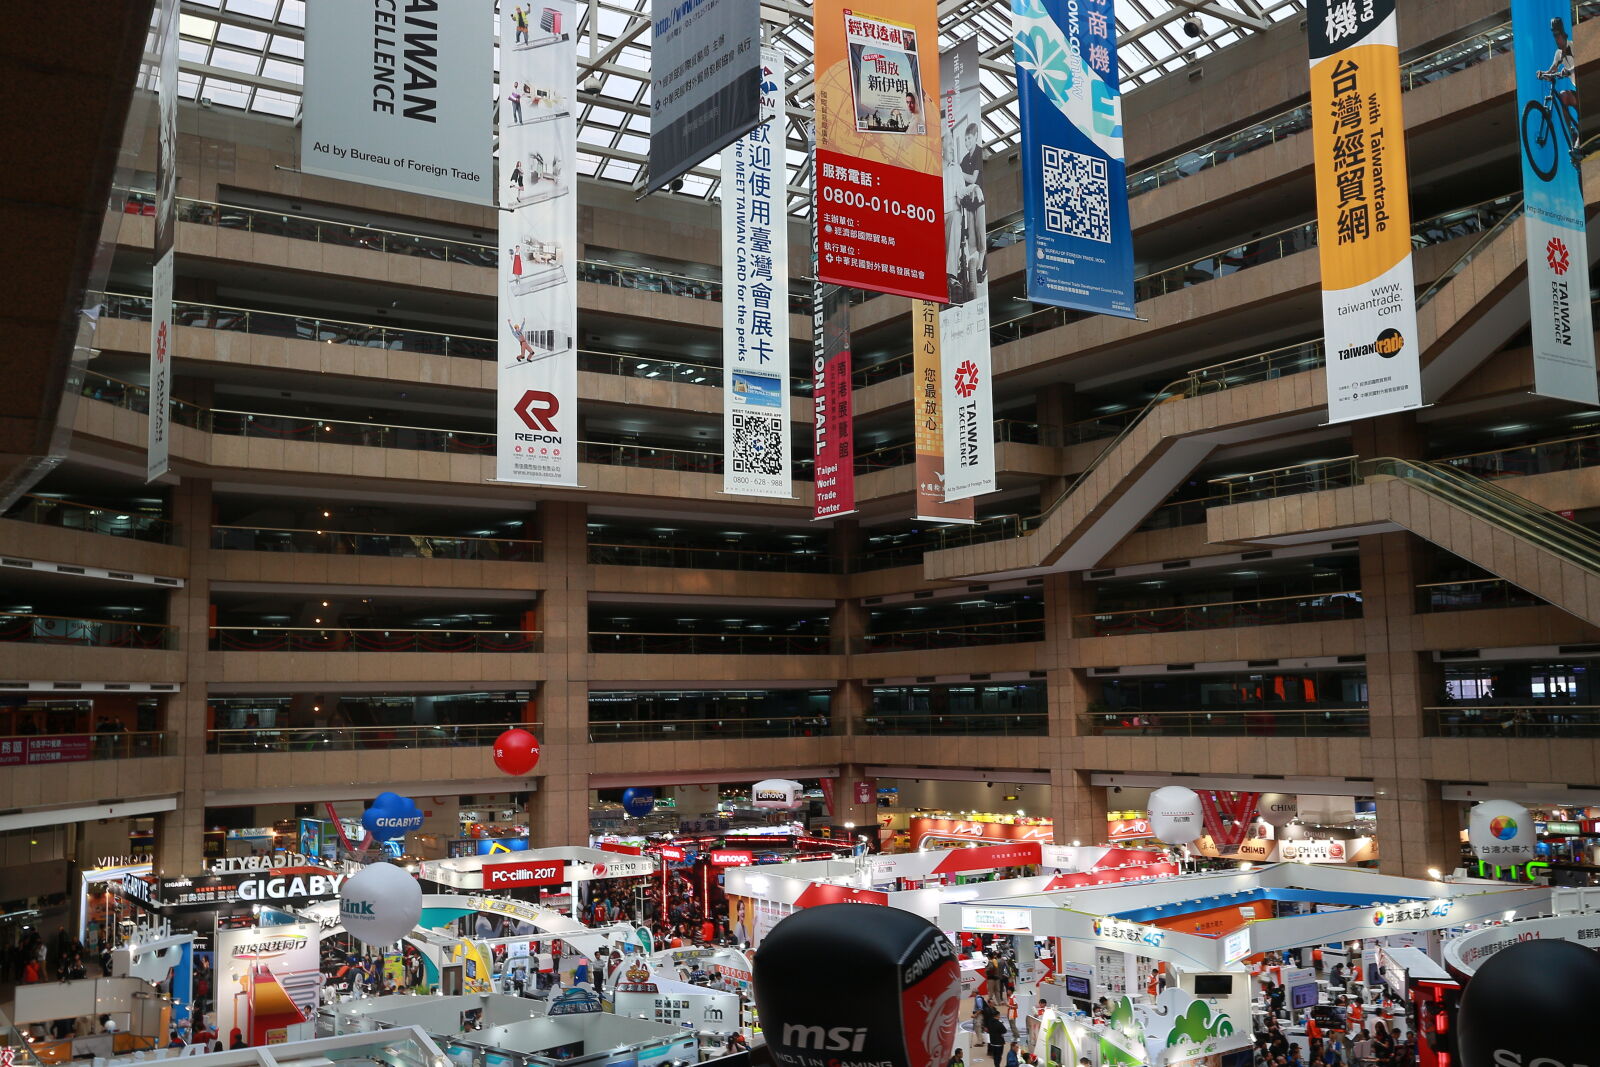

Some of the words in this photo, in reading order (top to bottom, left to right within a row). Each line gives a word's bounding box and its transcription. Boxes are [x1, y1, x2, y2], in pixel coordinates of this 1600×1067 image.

[848, 18, 903, 45] 經貿透視
[1325, 0, 1358, 44] 機
[1088, 0, 1111, 73] 商機
[874, 59, 900, 77] 開放
[867, 74, 909, 93] 新伊朗
[1368, 93, 1382, 125] with
[313, 141, 330, 153] Ad
[333, 145, 347, 159] by
[350, 148, 390, 167] Bureau
[393, 157, 405, 168] of
[407, 160, 448, 178] Foreign
[451, 167, 481, 182] Trade
[1330, 60, 1370, 246] 台灣經貿網
[735, 160, 746, 194] MEET
[1370, 127, 1390, 232] Taiwantrade
[823, 186, 936, 223] 0800-010-800
[735, 196, 747, 245] TAIWAN
[736, 247, 747, 282] CARD
[736, 284, 748, 303] for
[1371, 283, 1403, 297] www.
[736, 305, 748, 325] the
[1337, 292, 1403, 316] taiwantrade.
[1377, 303, 1401, 317] com
[1551, 281, 1562, 344] EXCELLENCE
[1558, 281, 1572, 346] TAIWAN
[736, 327, 748, 362] perks
[924, 367, 937, 432] 您最放心
[815, 396, 827, 456] HALL
[958, 406, 968, 468] EXCELLENCE
[966, 400, 979, 466] TAIWAN
[514, 432, 562, 445] REPON
[816, 463, 838, 476] Taipei
[816, 477, 836, 489] World
[817, 491, 837, 501] Trade
[817, 503, 841, 515] Center
[757, 791, 786, 800] Lenovo
[376, 817, 422, 828] GIGABYTE
[713, 853, 750, 865] Lenovo
[1240, 845, 1266, 855] CHIMEI
[1481, 845, 1530, 854] 台灣大哥大
[492, 870, 534, 883] PC-cillin
[535, 867, 557, 880] 2017
[609, 862, 637, 872] TREND
[164, 880, 193, 888] GIGABYTE
[238, 875, 343, 901] GIGABY
[1387, 907, 1430, 924] 台灣大哥大
[1517, 930, 1541, 943] NO1
[904, 943, 940, 984] GAMING
[782, 1022, 869, 1053] msi
[808, 1057, 824, 1067] IN
